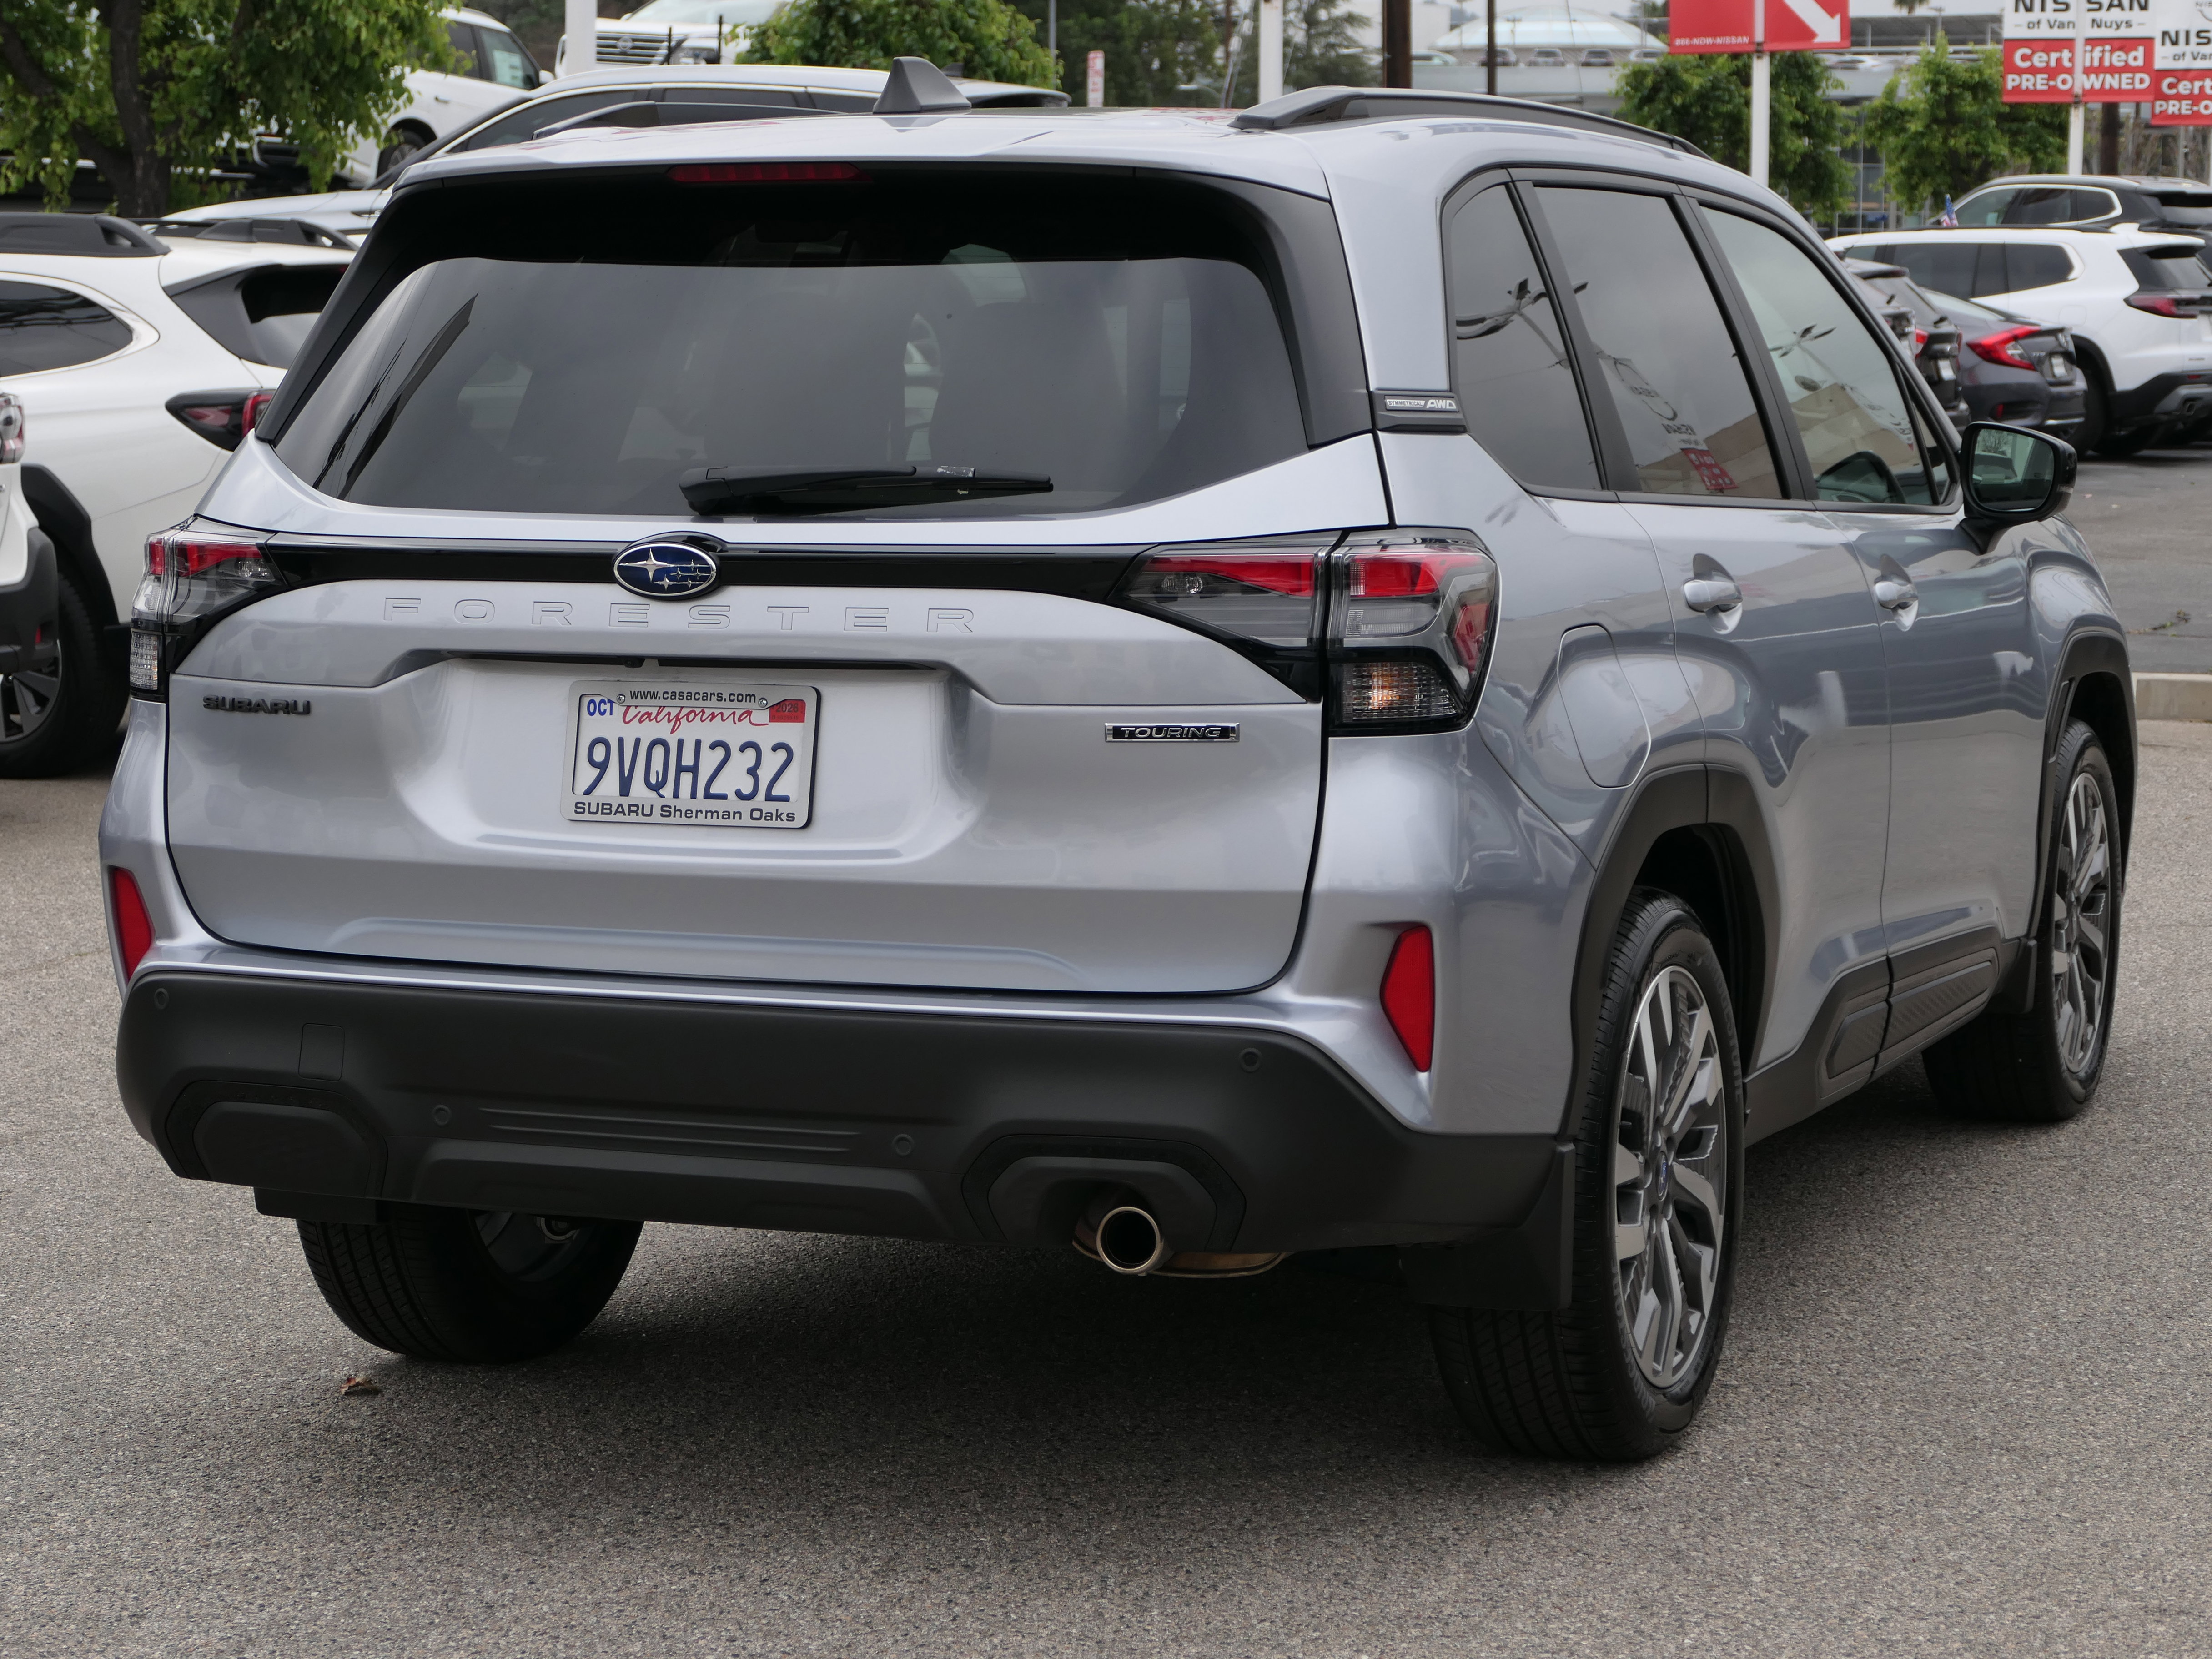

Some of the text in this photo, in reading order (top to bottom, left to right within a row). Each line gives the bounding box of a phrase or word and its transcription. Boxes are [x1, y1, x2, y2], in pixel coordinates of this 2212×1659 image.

[2027, 18, 2133, 31] of Van Nuys
[2173, 51, 2186, 61] of
[1426, 399, 1457, 409] AWD
[383, 597, 974, 633] FORESTER
[630, 690, 756, 703] www.casacars.com
[203, 694, 311, 715] SUBARU
[587, 699, 614, 717] OCT
[776, 703, 799, 713] 2026
[622, 705, 769, 735] California
[1121, 727, 1222, 738] TOURING
[583, 736, 794, 802] 9VQH232
[574, 801, 796, 822] SUBARU Sherman Oaks
